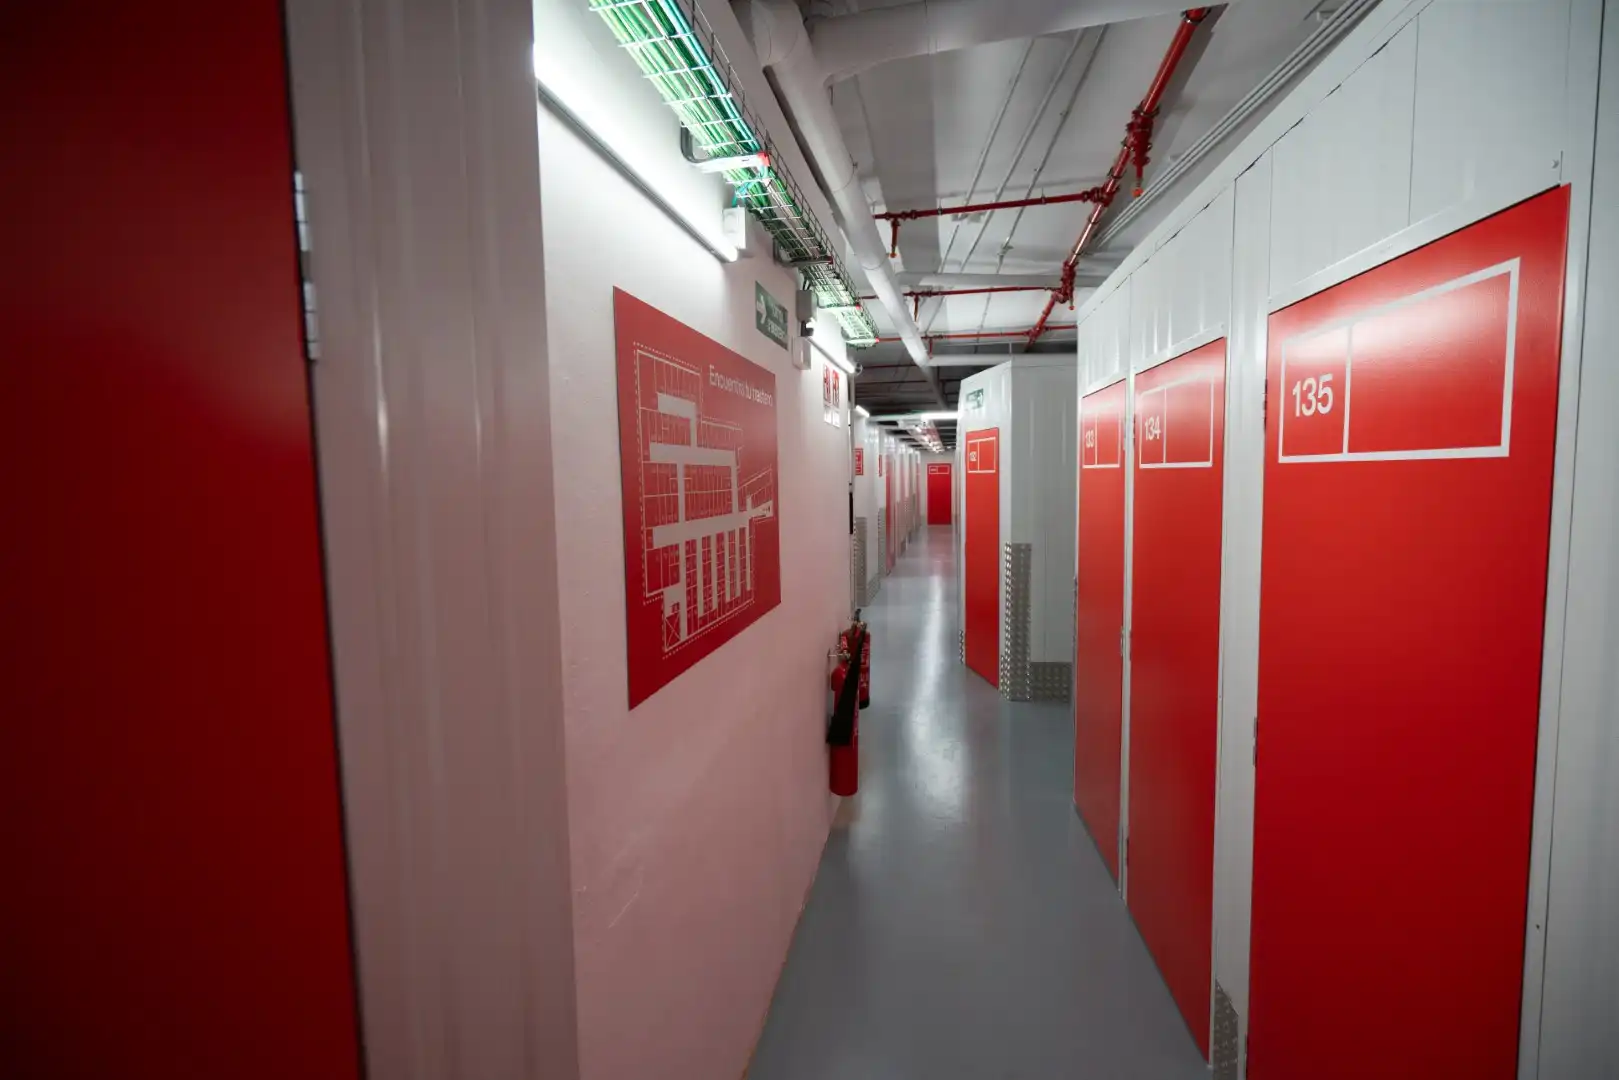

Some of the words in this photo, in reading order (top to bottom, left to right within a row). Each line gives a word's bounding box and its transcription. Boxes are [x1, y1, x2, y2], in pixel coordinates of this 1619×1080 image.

[1292, 373, 1334, 418] 135
[1085, 429, 1095, 448] 133
[1144, 415, 1162, 441] 134
